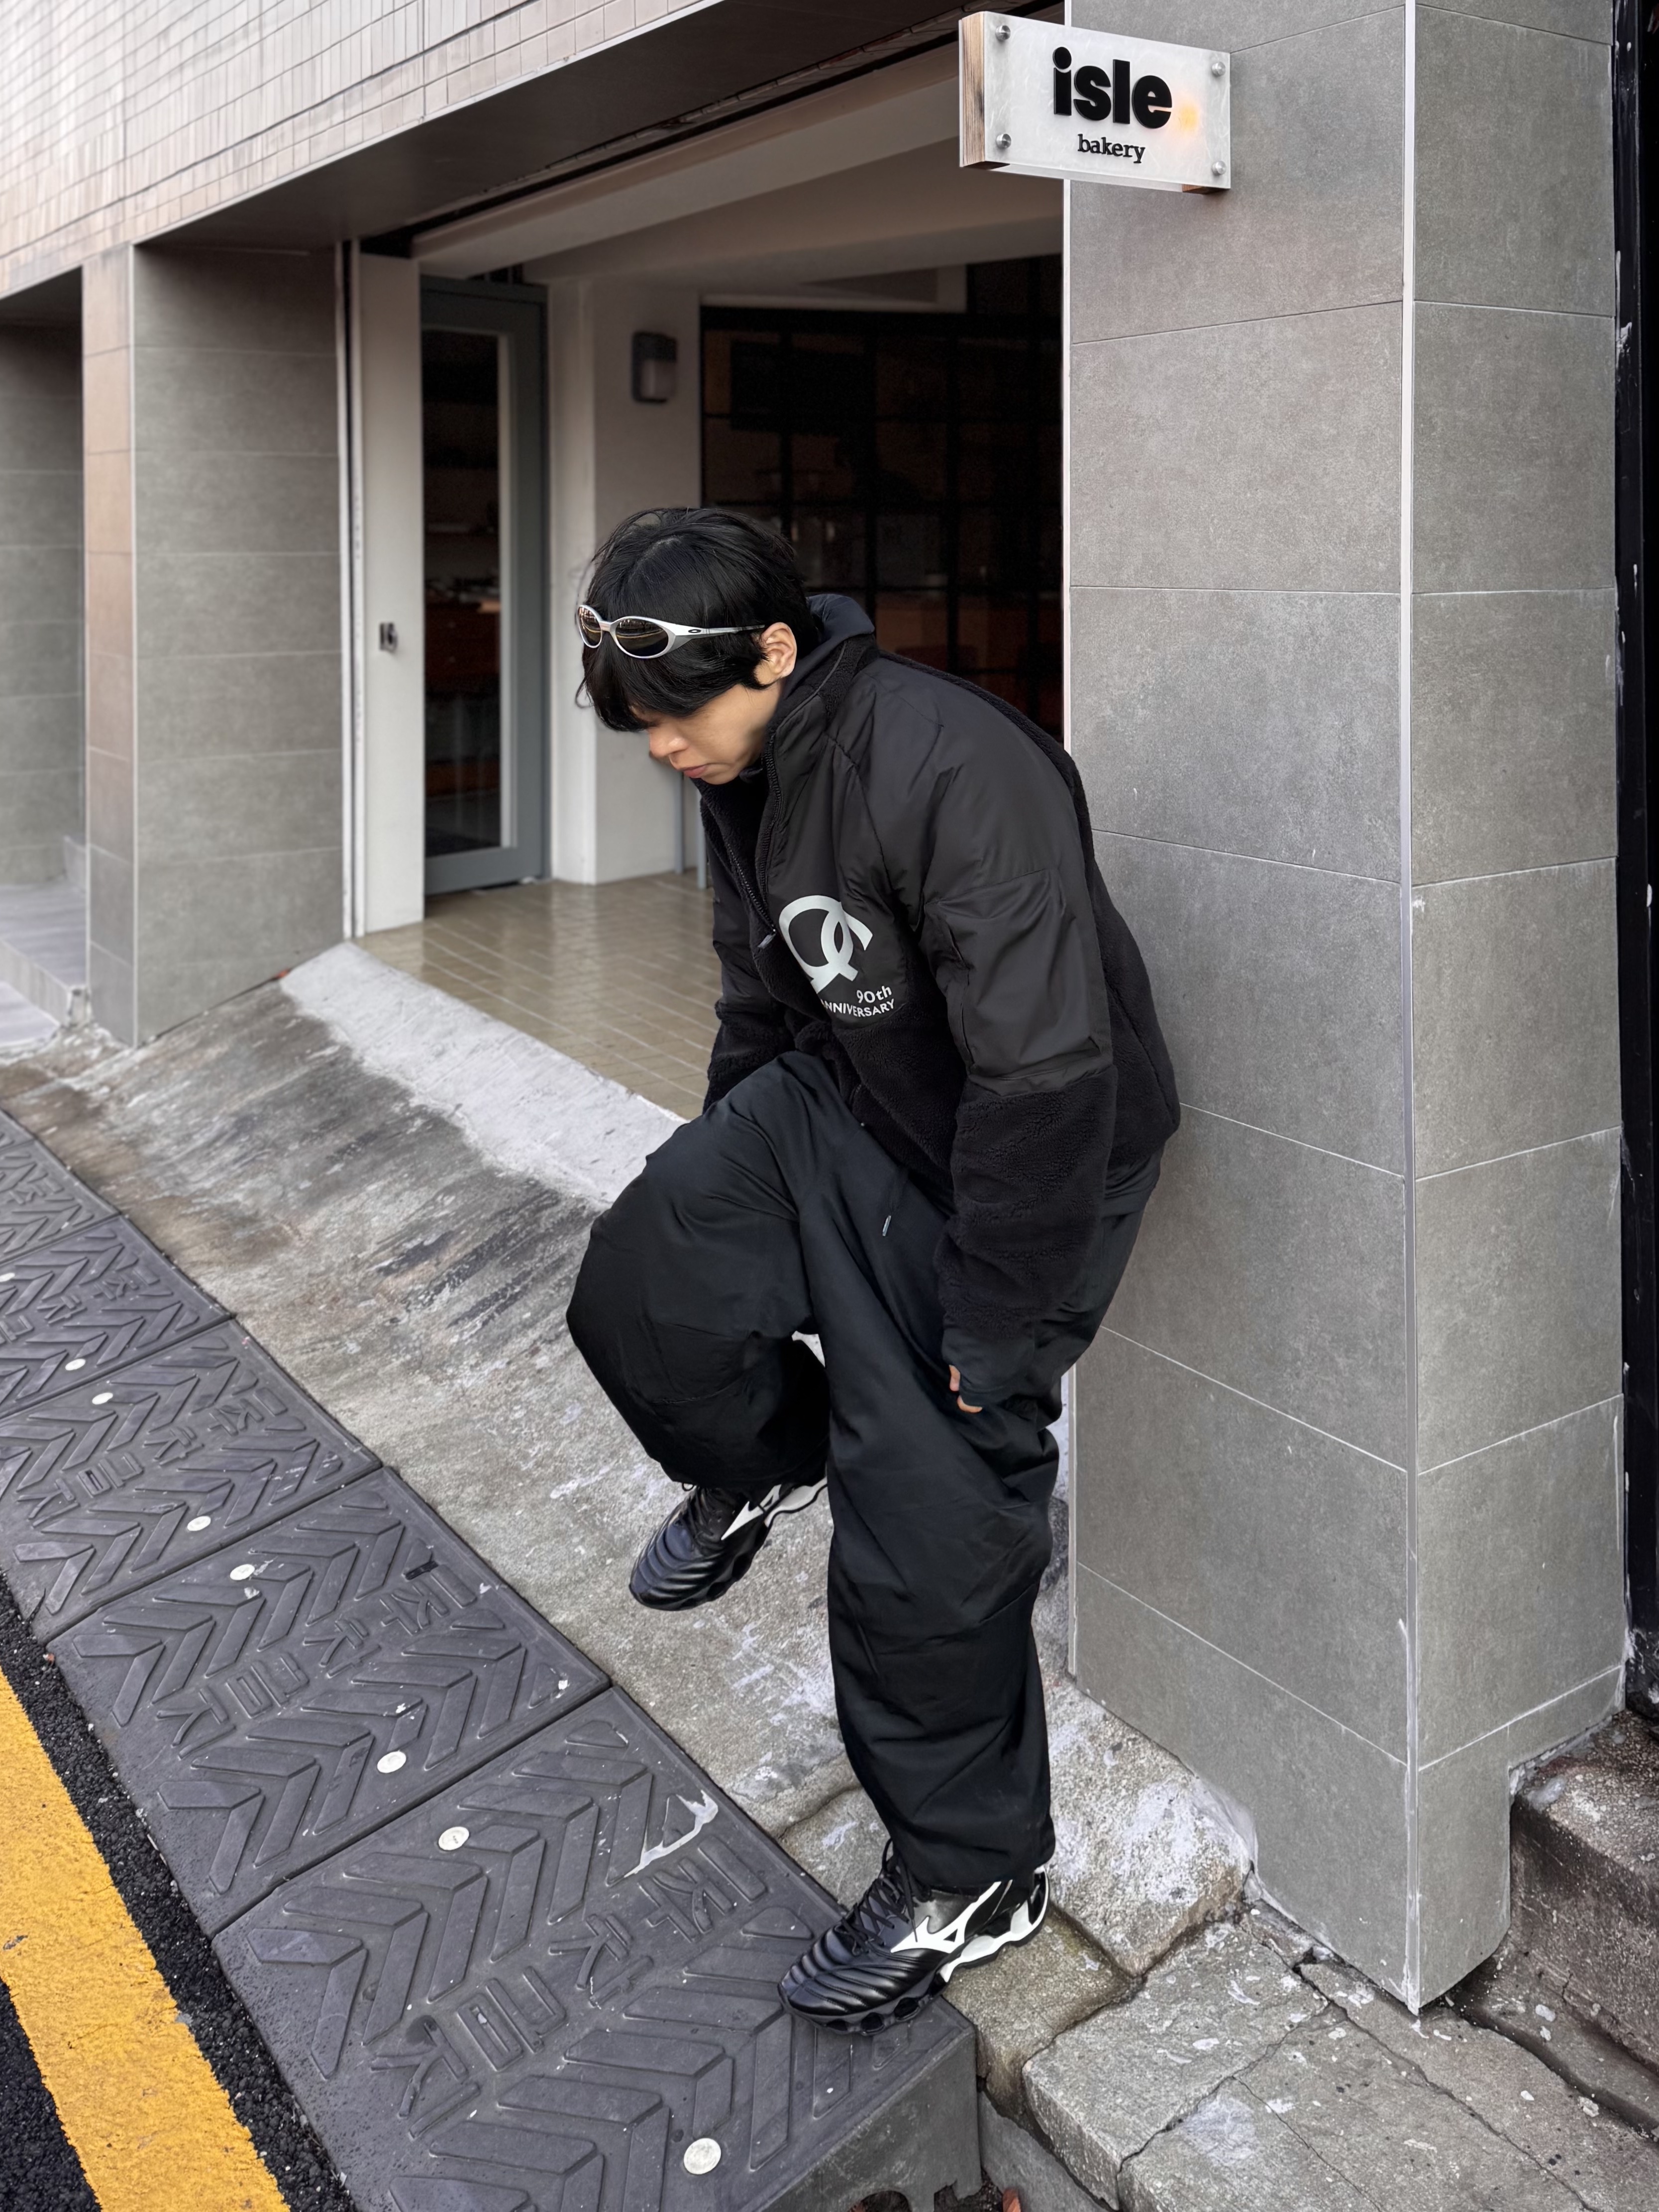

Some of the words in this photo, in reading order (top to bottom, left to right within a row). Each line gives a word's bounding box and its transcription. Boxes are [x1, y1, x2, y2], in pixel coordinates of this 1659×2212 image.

[1052, 46, 1173, 129] isle
[1077, 133, 1146, 164] bakery
[856, 985, 892, 1004] 90th
[156, 1579, 450, 1760] 주차금지
[370, 1857, 734, 2138] 주차금지
